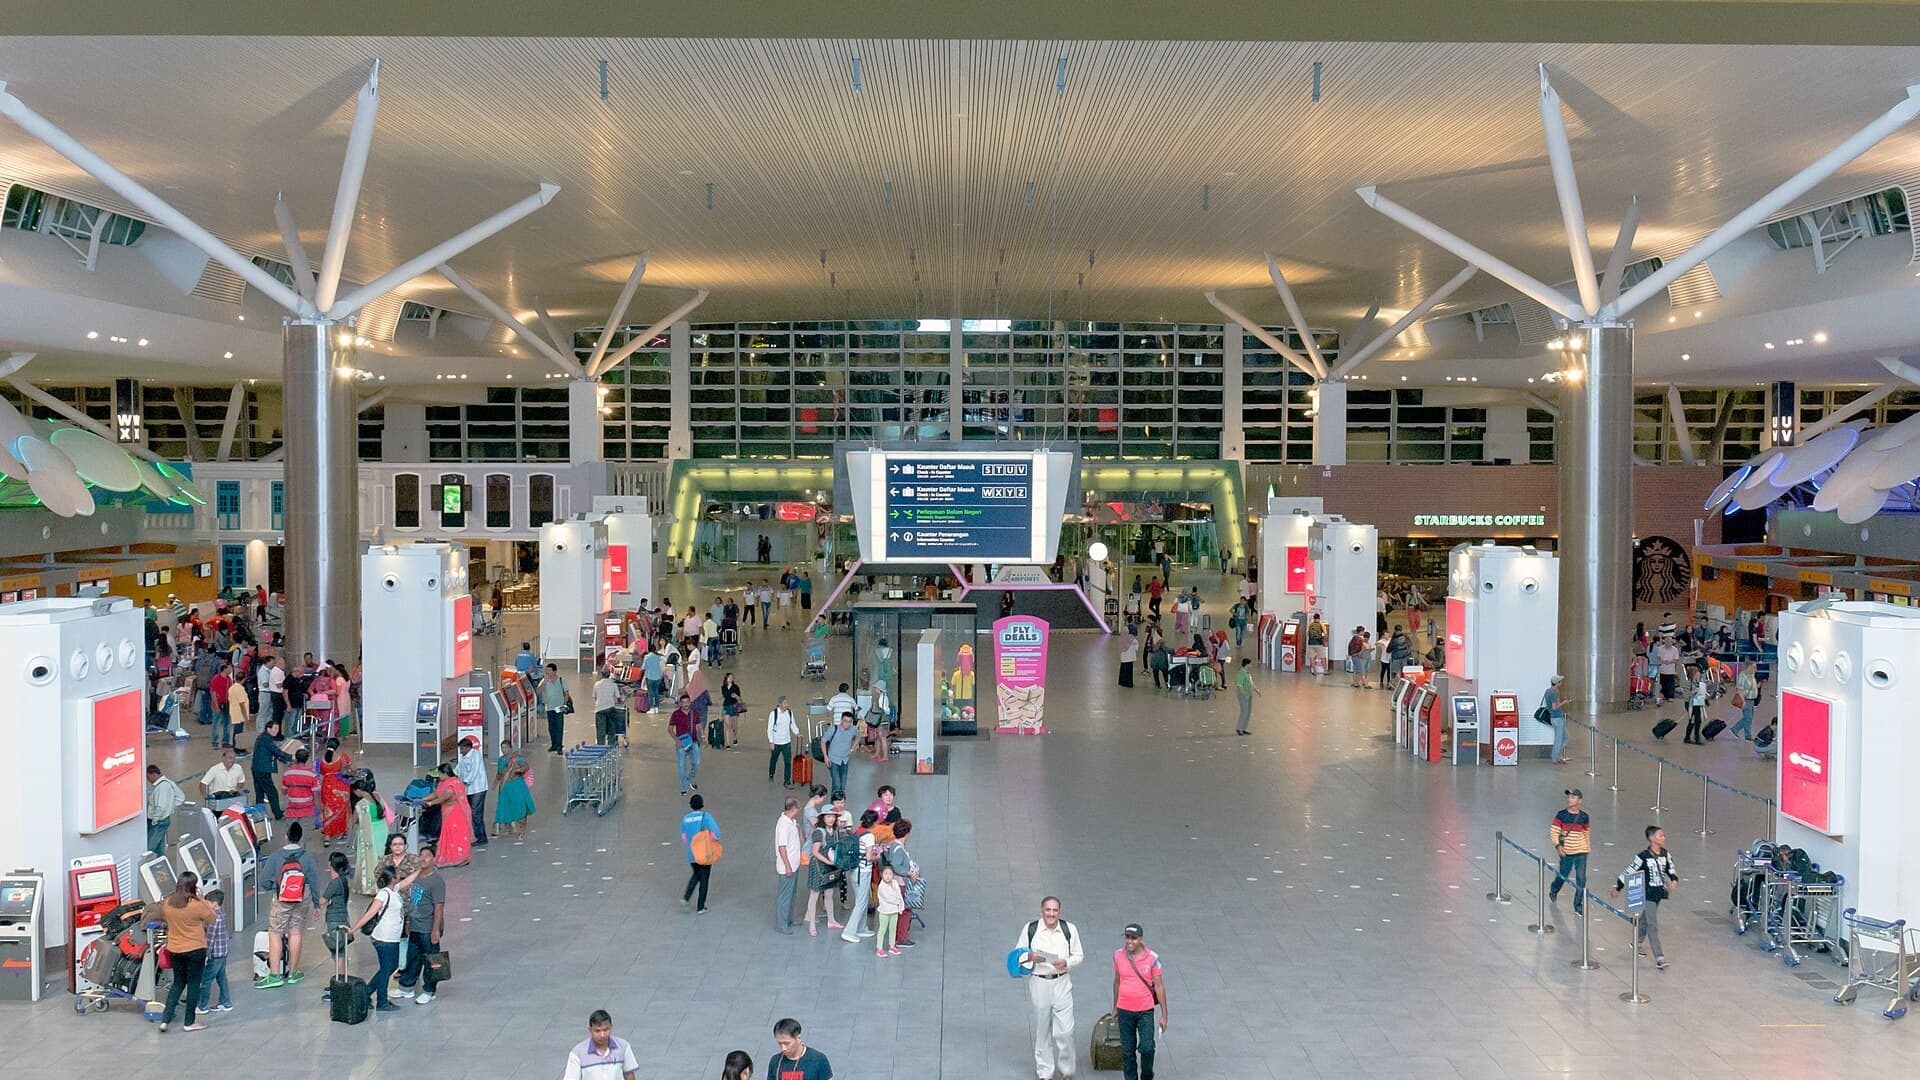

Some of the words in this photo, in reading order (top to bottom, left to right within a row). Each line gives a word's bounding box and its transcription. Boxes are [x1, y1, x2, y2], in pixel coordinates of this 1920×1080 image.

[117, 414, 132, 426] W
[1781, 415, 1792, 428] U
[119, 427, 131, 440] X
[1781, 429, 1792, 442] V
[1414, 514, 1493, 526] STARBUCKS
[1494, 514, 1545, 526] COFFEE
